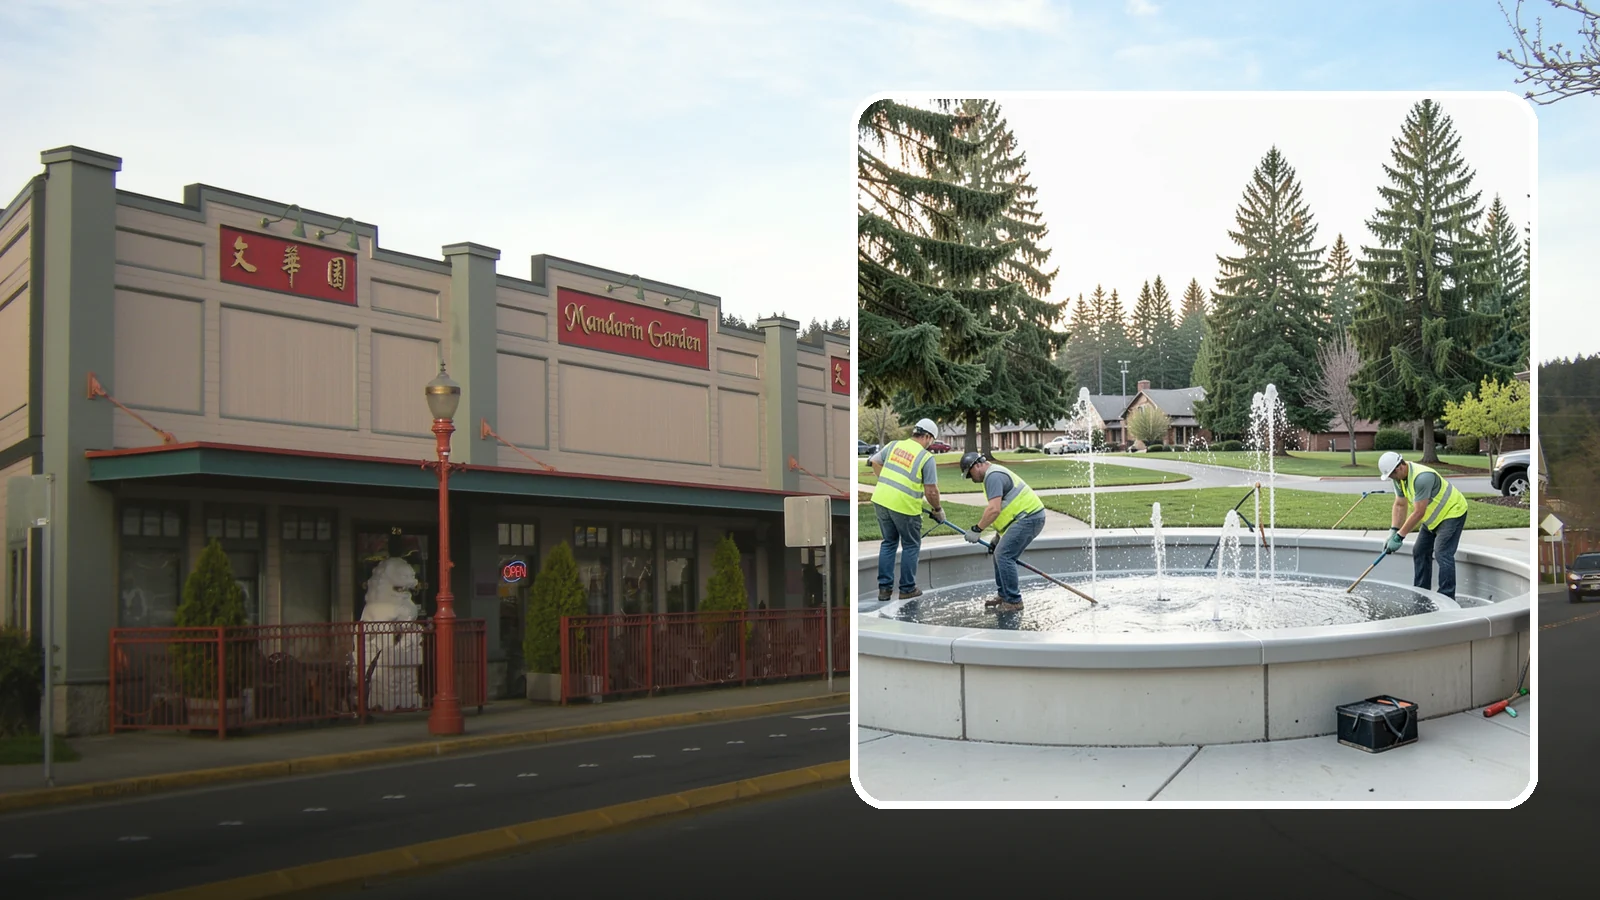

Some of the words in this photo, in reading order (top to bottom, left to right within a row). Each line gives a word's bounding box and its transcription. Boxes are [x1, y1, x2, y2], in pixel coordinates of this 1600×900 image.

[230, 235, 346, 291] 文華園
[564, 302, 644, 341] Mandarin
[648, 320, 701, 352] Garden
[503, 565, 527, 578] OPEN
